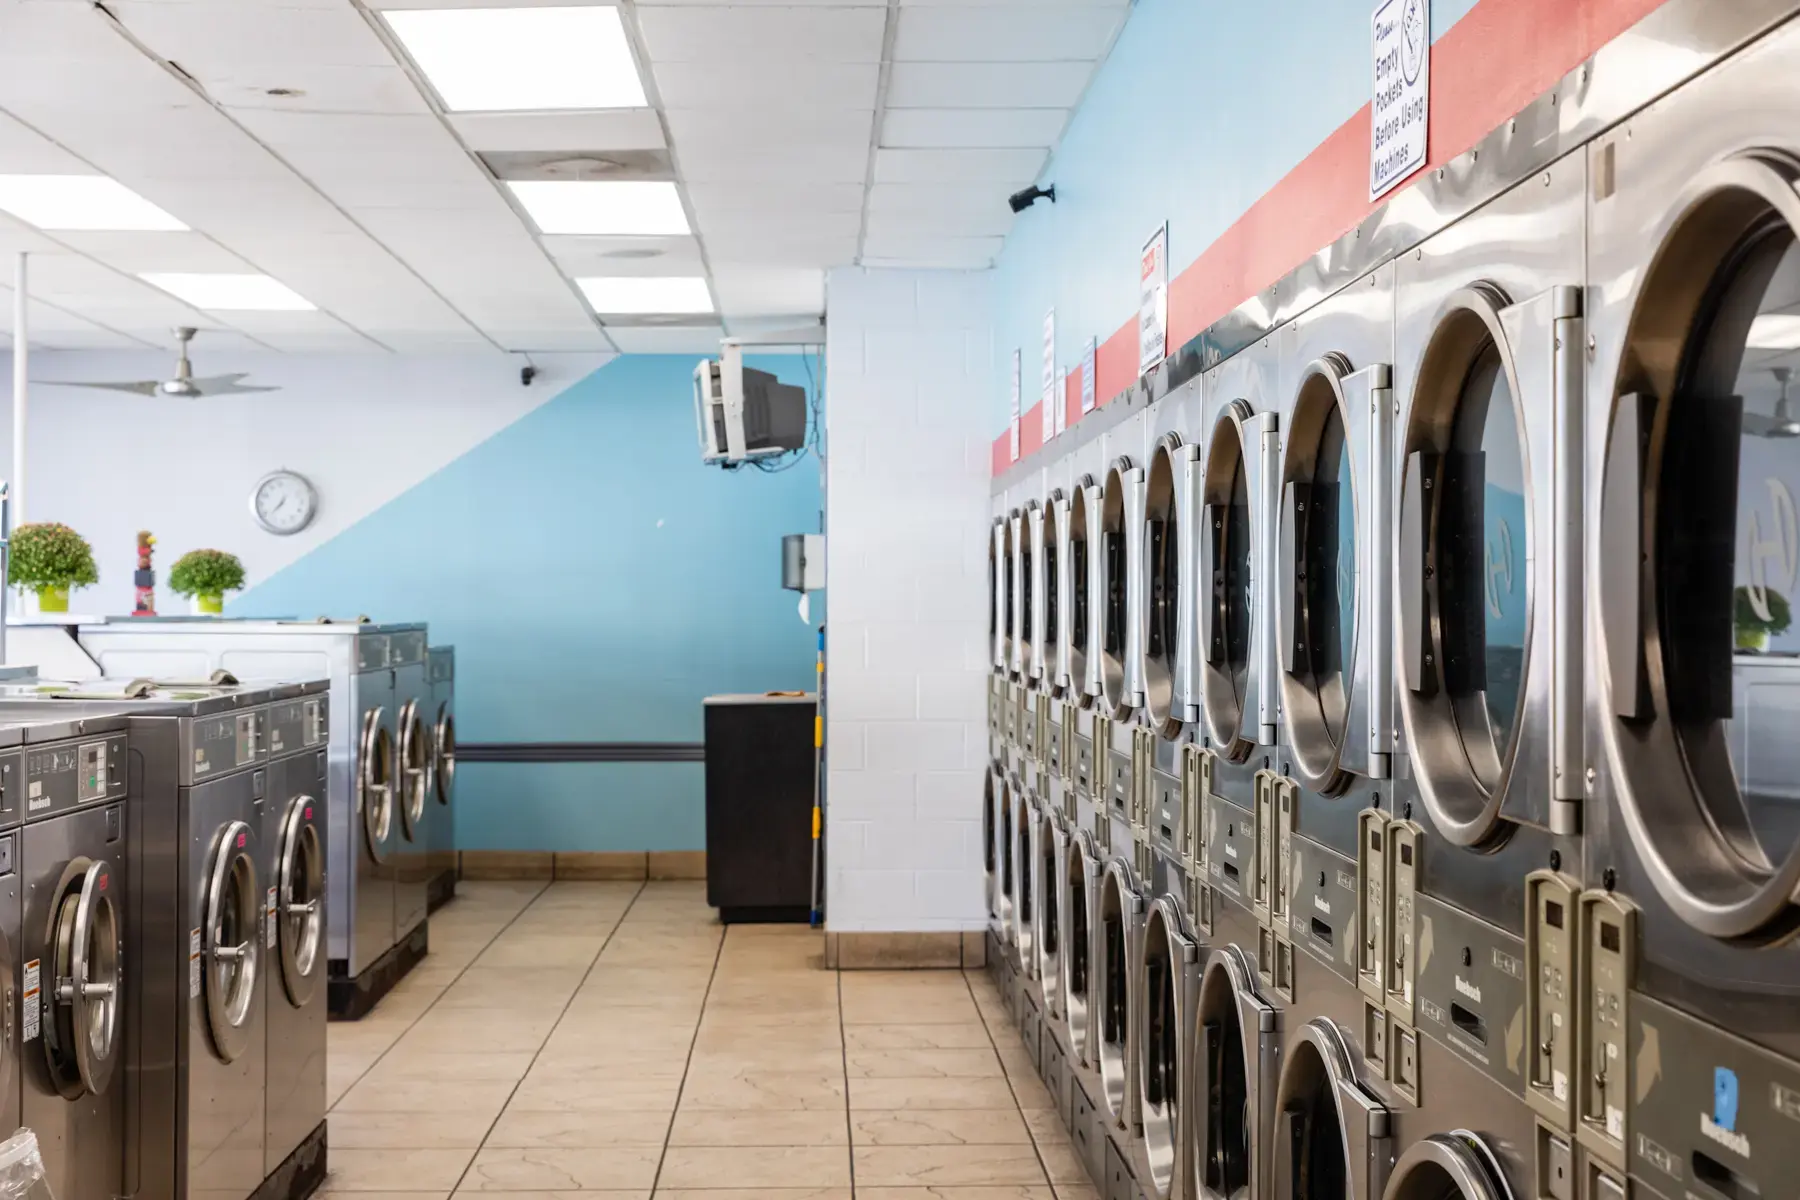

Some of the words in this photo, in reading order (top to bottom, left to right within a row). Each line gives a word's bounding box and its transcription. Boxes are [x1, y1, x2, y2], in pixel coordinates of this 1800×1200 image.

[1376, 45, 1399, 81] Empty
[1375, 78, 1403, 116] Pockets
[1375, 114, 1399, 150] Before
[1401, 96, 1424, 128] Using
[1374, 142, 1409, 183] Machines
